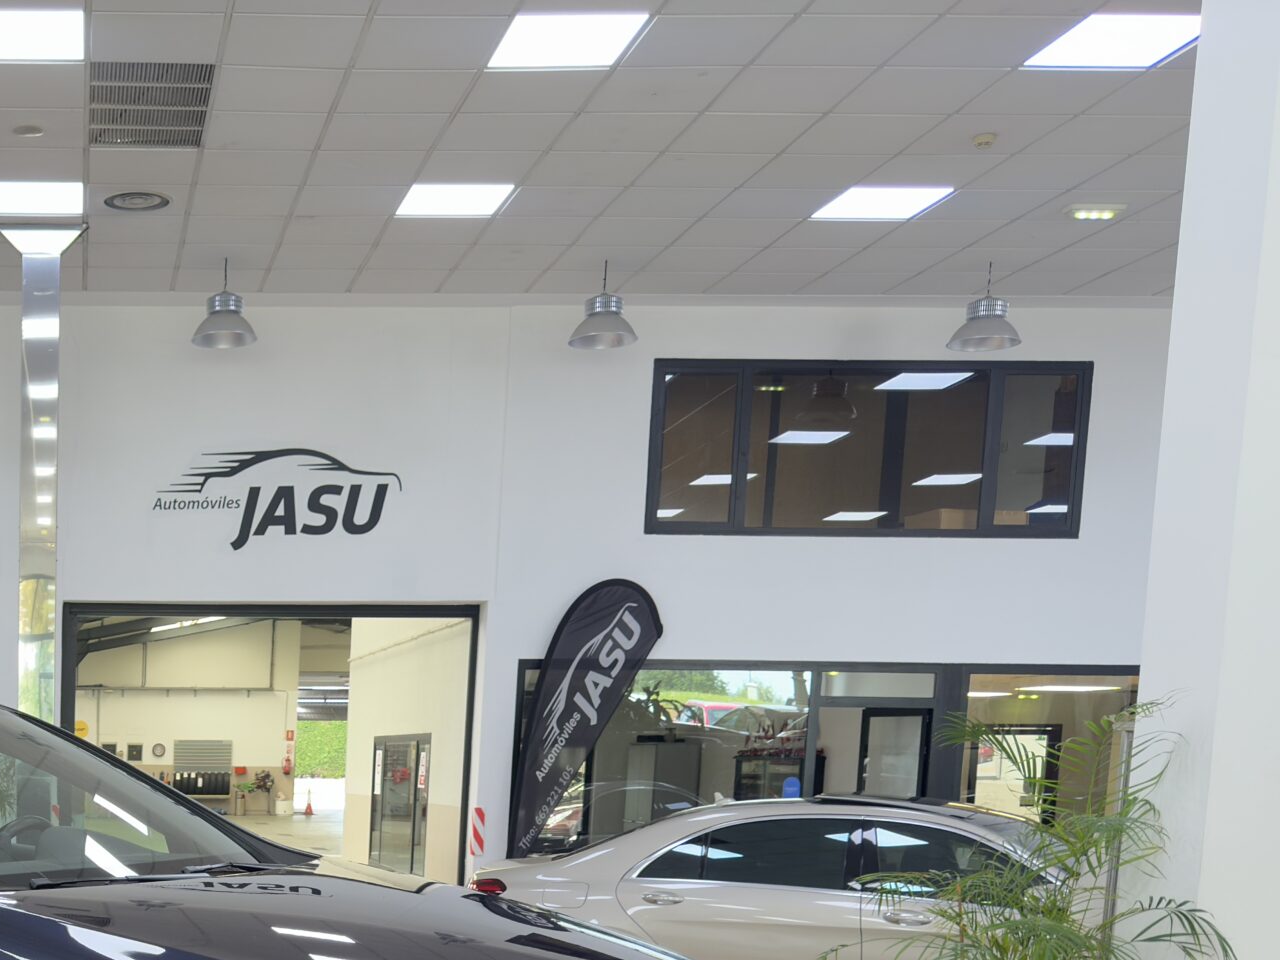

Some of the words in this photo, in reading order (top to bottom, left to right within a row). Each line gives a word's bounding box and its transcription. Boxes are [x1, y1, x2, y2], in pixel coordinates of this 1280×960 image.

[153, 496, 241, 511] Automóviles
[230, 483, 389, 551] JASU
[573, 610, 641, 726] JASU
[535, 712, 581, 782] Automóviles
[535, 805, 549, 825] 669
[546, 786, 562, 806] 221
[559, 765, 574, 785] 105
